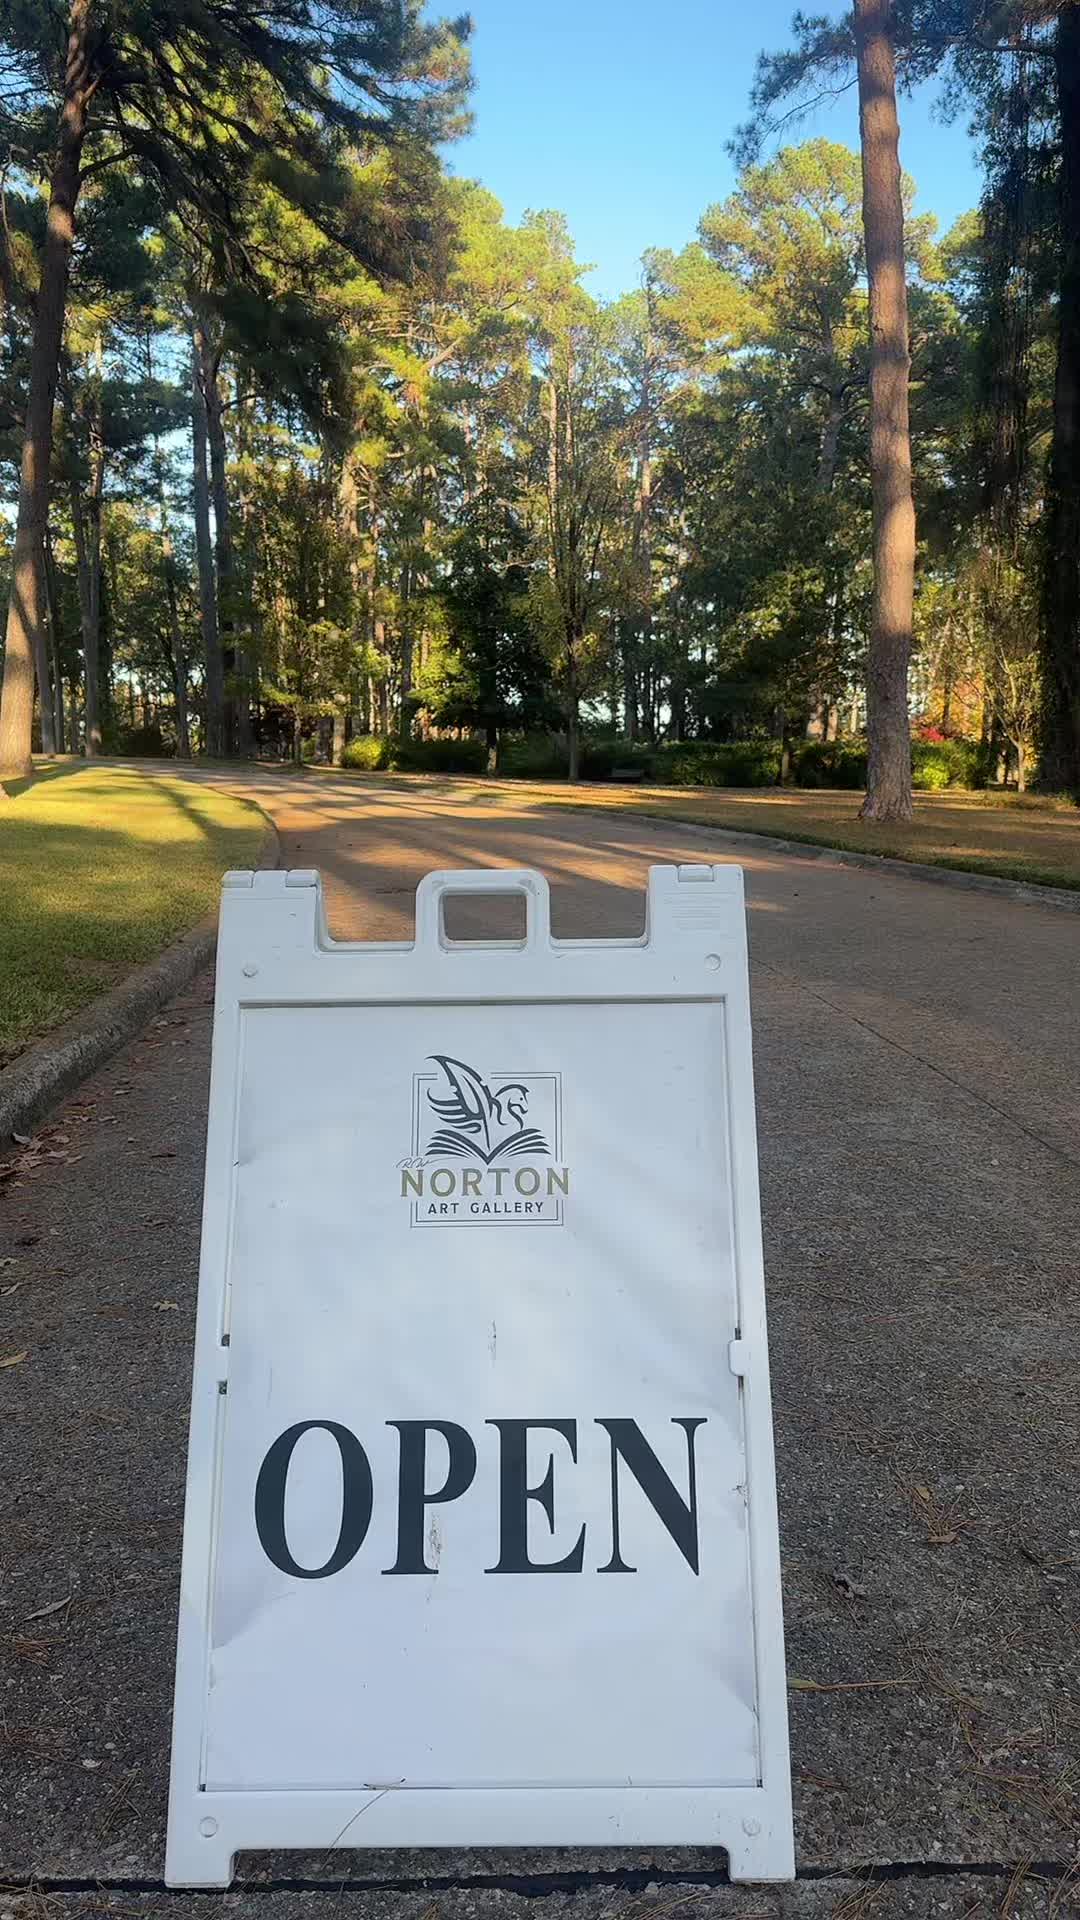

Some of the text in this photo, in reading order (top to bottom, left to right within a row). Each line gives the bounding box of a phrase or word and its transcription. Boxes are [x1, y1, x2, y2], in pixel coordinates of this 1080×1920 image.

[400, 1167, 569, 1197] NORTON
[427, 1202, 544, 1214] ART GALLERY
[254, 1418, 708, 1580] OPEN
